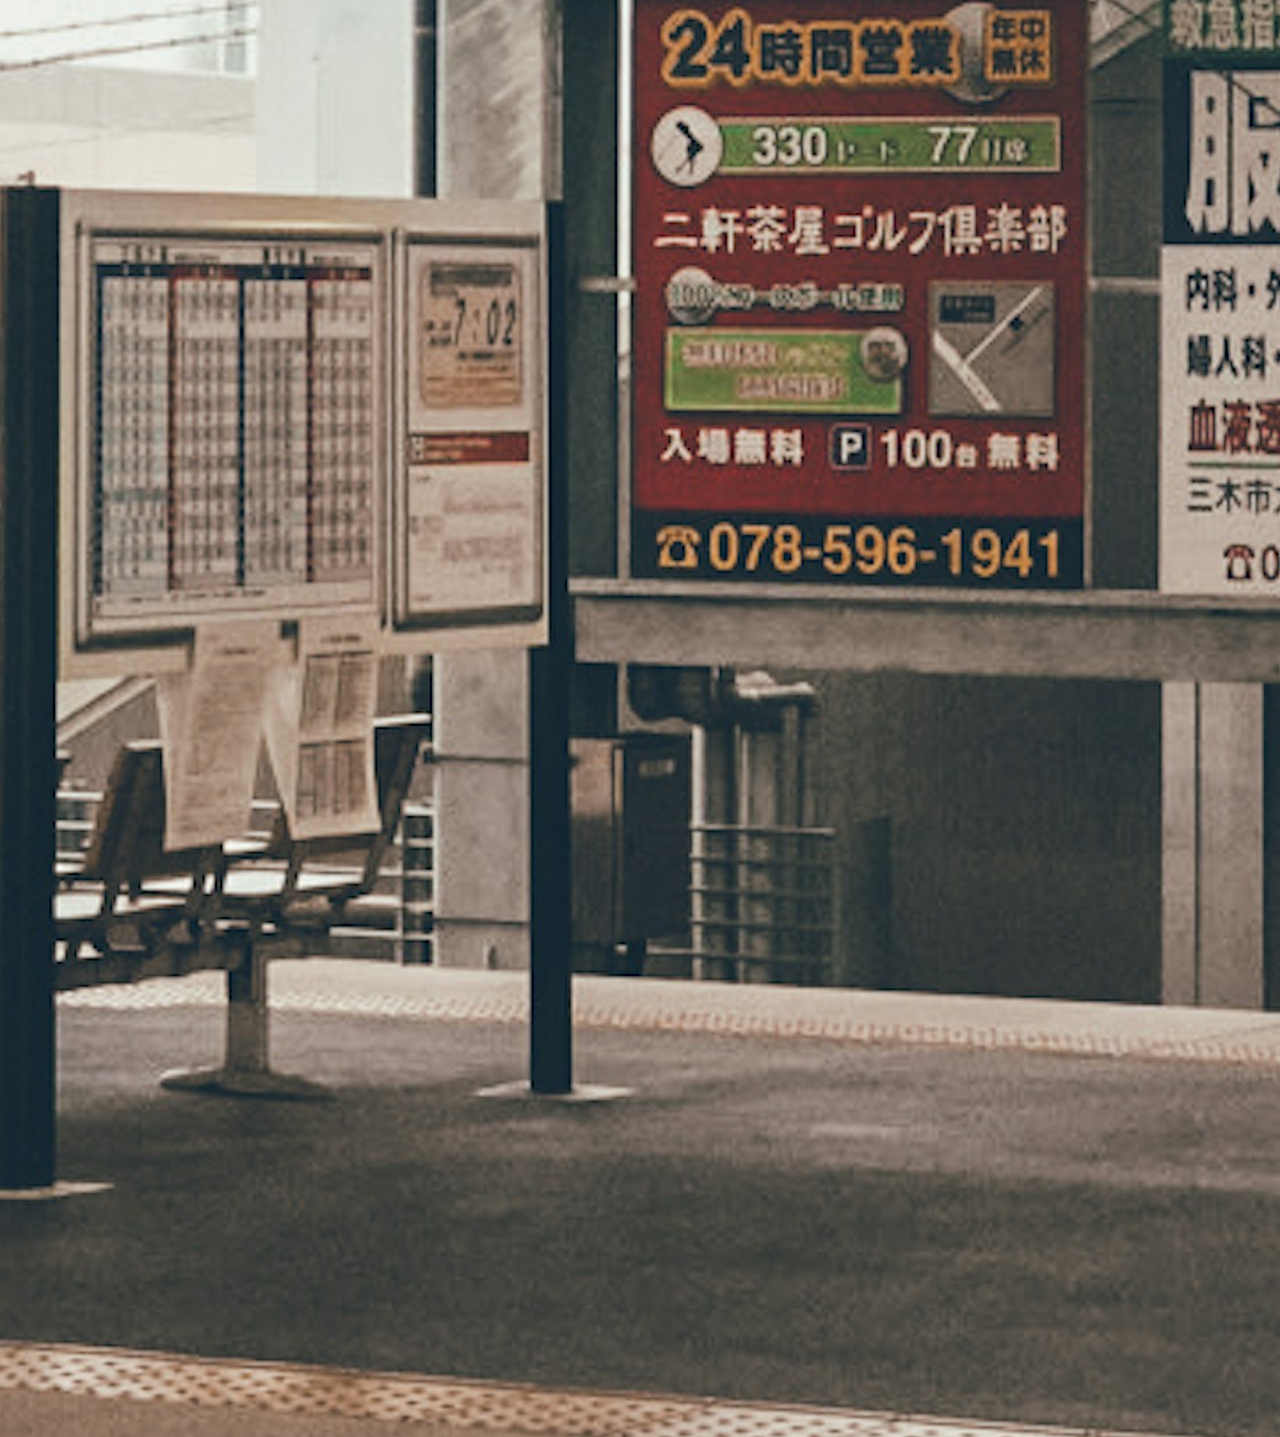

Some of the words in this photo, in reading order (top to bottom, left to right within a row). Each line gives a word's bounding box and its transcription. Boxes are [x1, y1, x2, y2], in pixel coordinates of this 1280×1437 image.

[663, 9, 962, 87] 24時間営業
[653, 202, 1069, 257] 二軒茶屋ゴルフ倶楽部
[659, 427, 805, 467] 入場無料
[708, 523, 1061, 580] 078-596-1941
